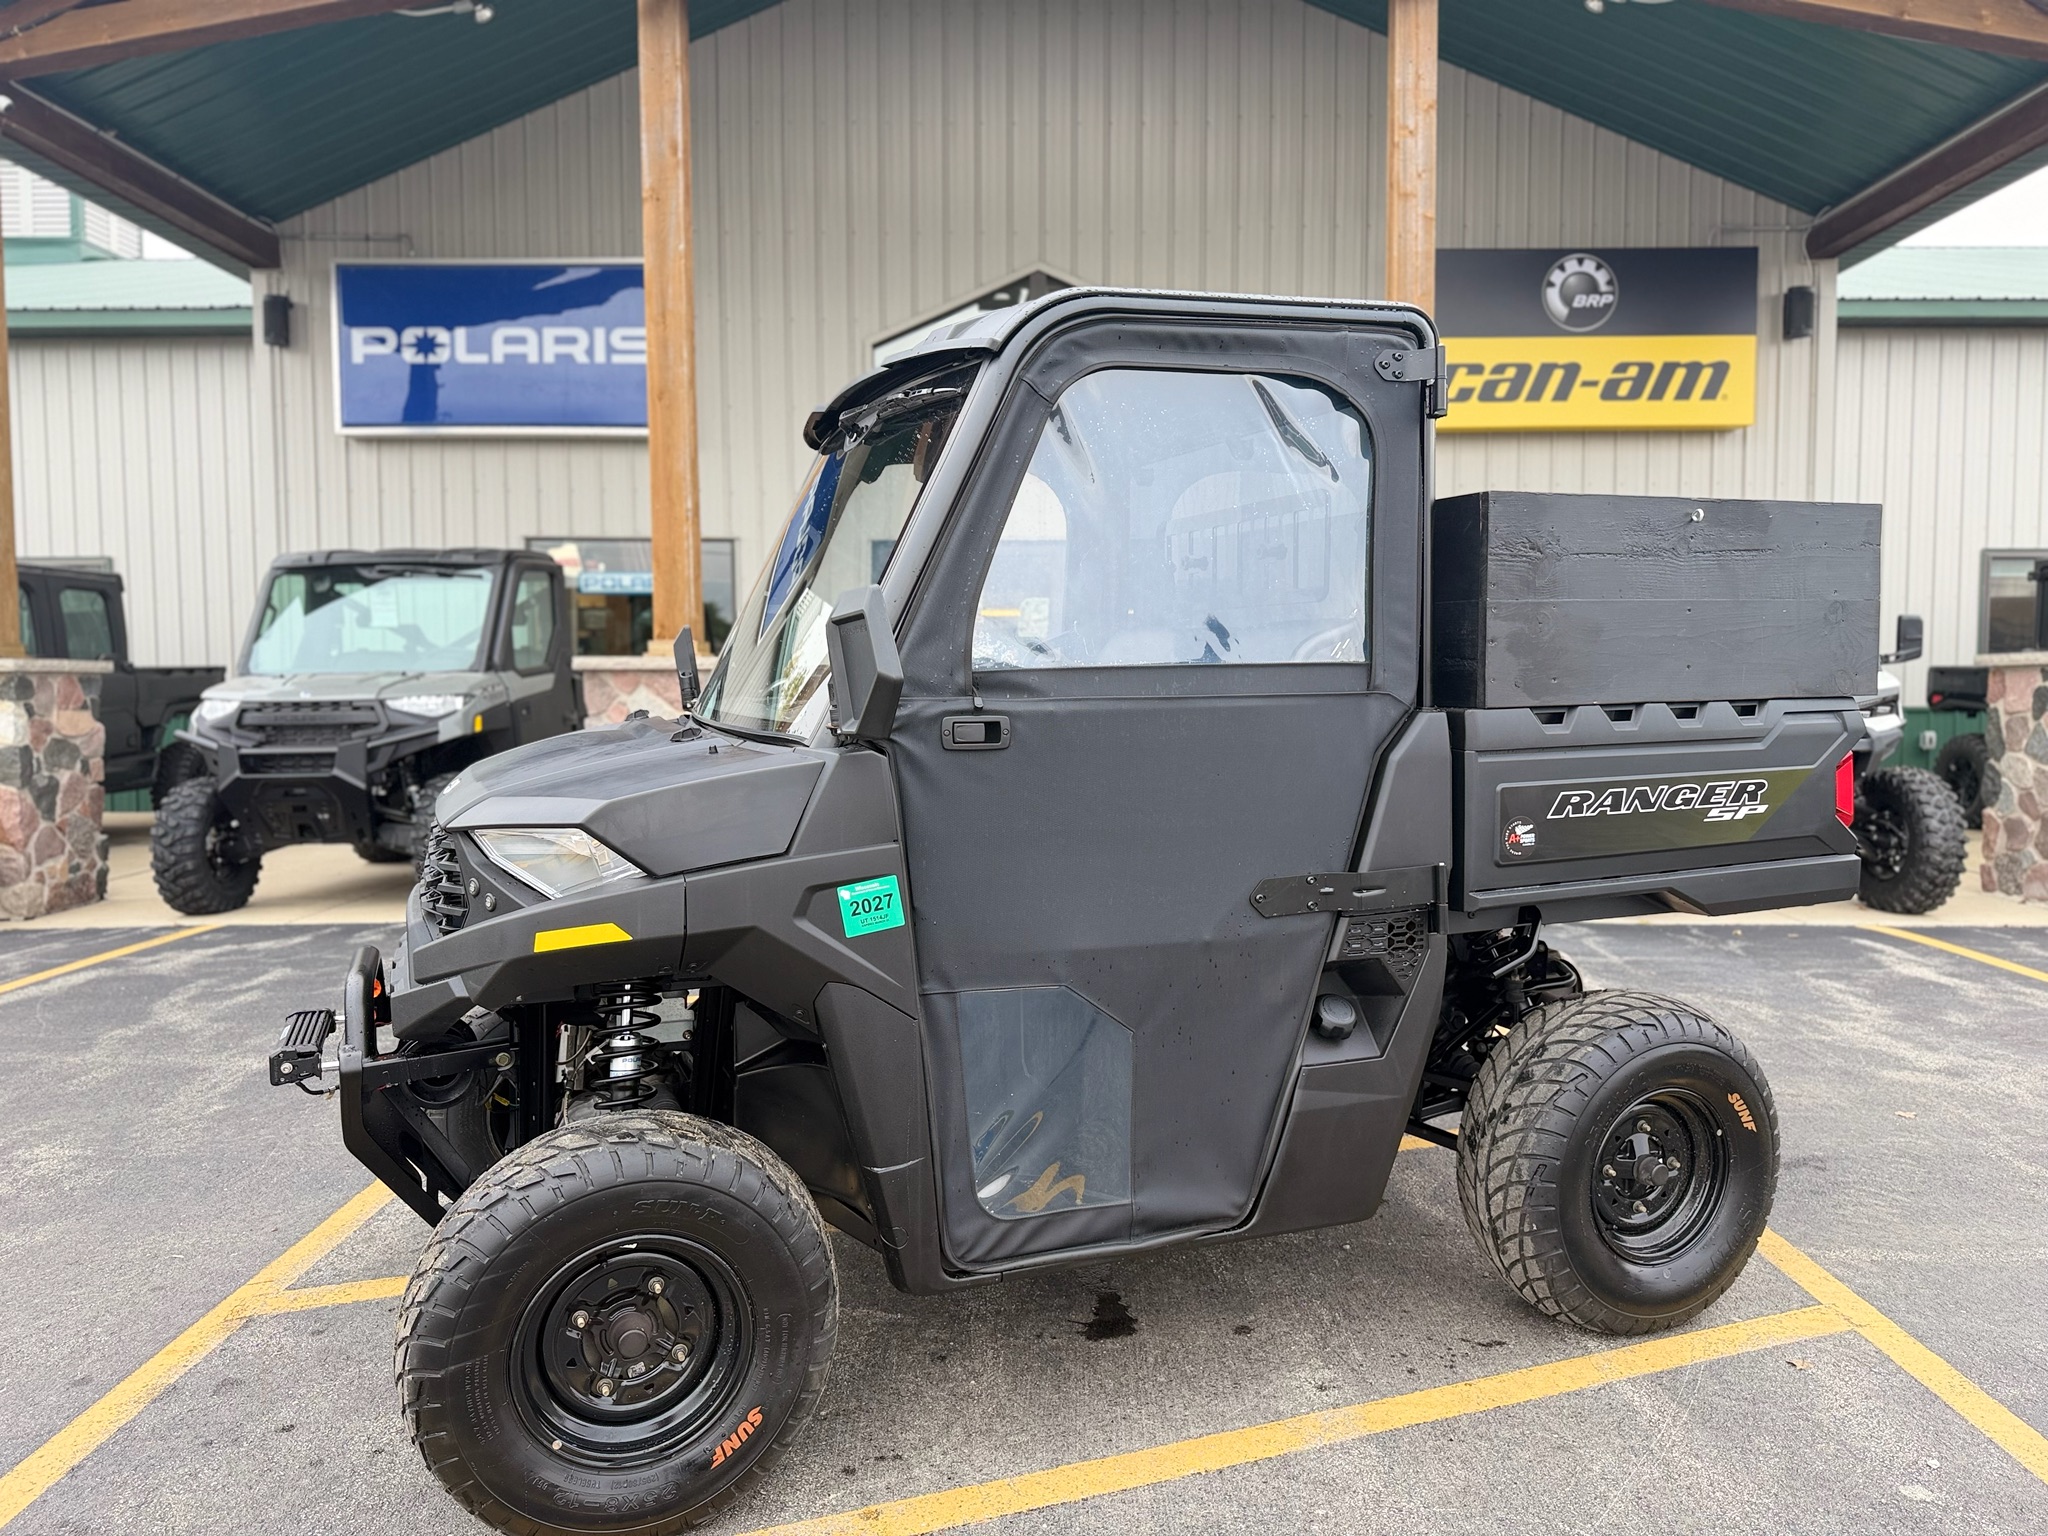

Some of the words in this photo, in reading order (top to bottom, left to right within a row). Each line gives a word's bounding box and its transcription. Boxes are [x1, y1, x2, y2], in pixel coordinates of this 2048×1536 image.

[1572, 294, 1614, 308] BRP
[350, 326, 647, 365] POLARIS
[1447, 360, 1731, 402] can-am
[1547, 779, 1768, 819] RANGER
[1703, 804, 1769, 823] SP
[849, 893, 893, 917] 2027
[1727, 1092, 1757, 1133] SUNF
[711, 1405, 763, 1469] SUNF
